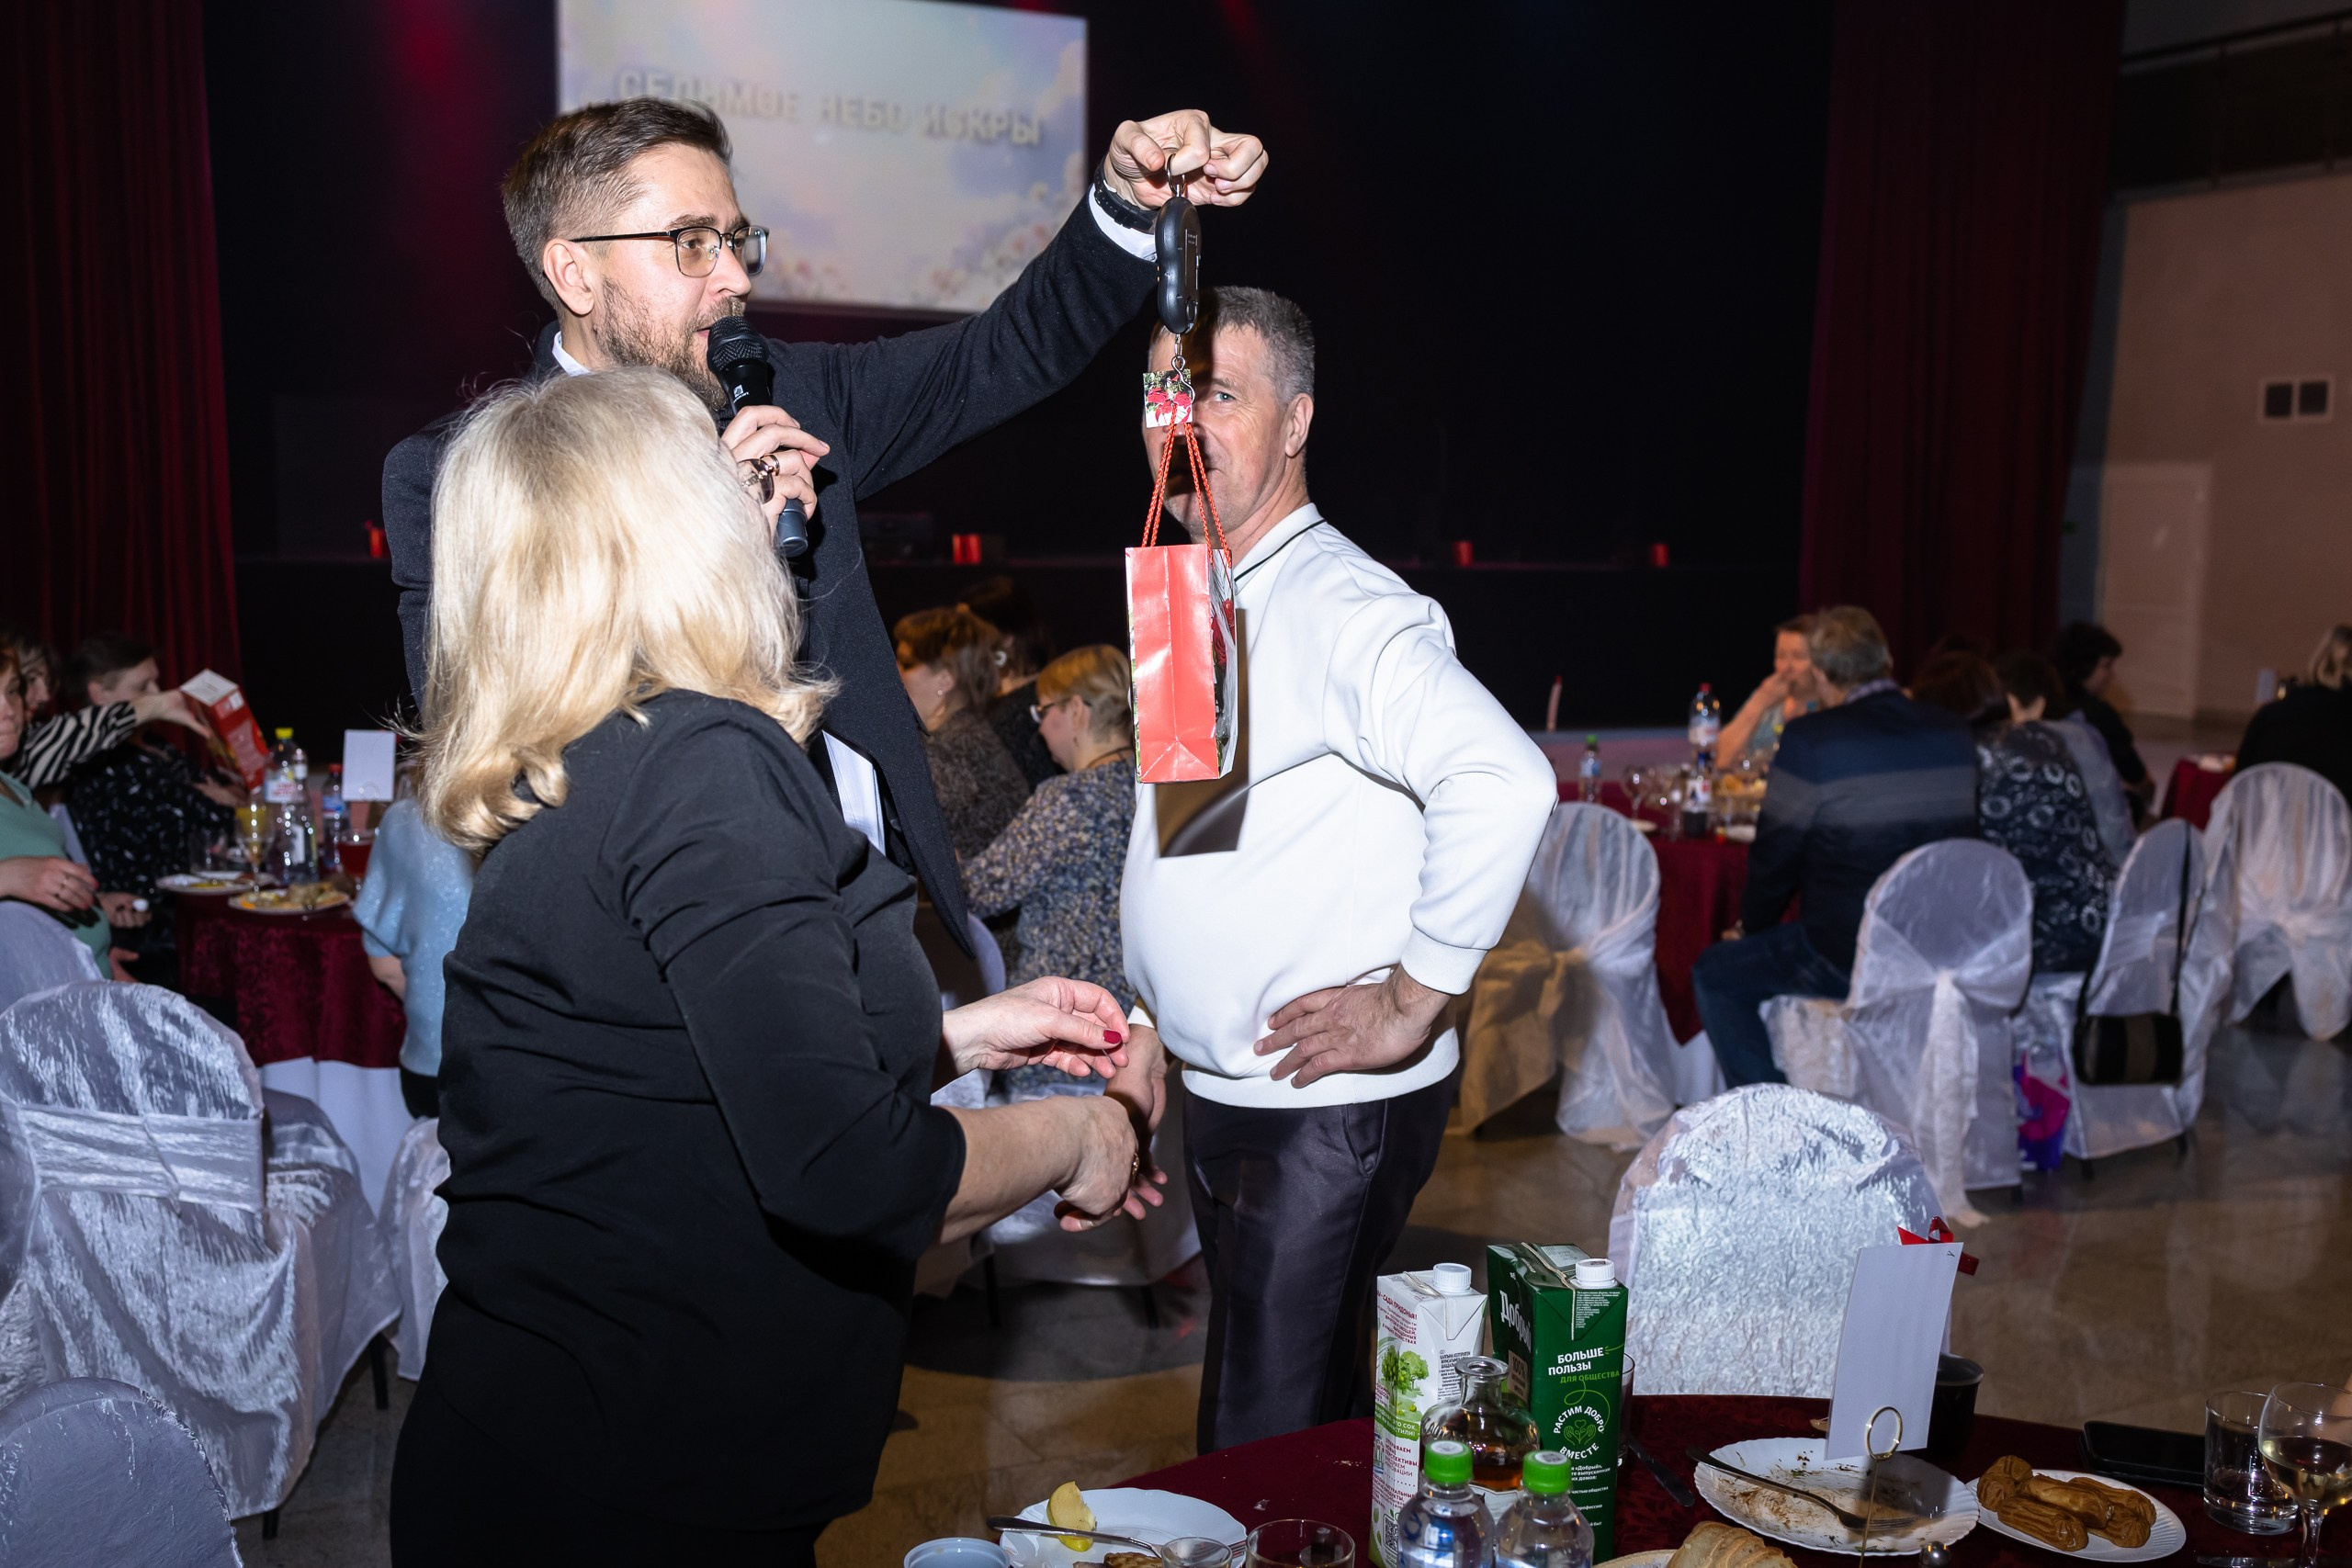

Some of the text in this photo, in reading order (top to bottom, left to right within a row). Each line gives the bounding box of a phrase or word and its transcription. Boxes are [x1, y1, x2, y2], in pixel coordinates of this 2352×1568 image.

[820, 94, 907, 132] НЕБО
[916, 103, 1042, 146] ИСКРЫ
[1557, 1347, 1604, 1364] БОЛЬШЕ
[1548, 1361, 1591, 1376] ПОЛЬЗЫ
[1560, 1371, 1620, 1384] ДЛЯ ОБЩЕСТВА
[1554, 1405, 1605, 1434] РАСТИМ ДОБРО
[1559, 1442, 1600, 1460] ВМЕСТЕ
